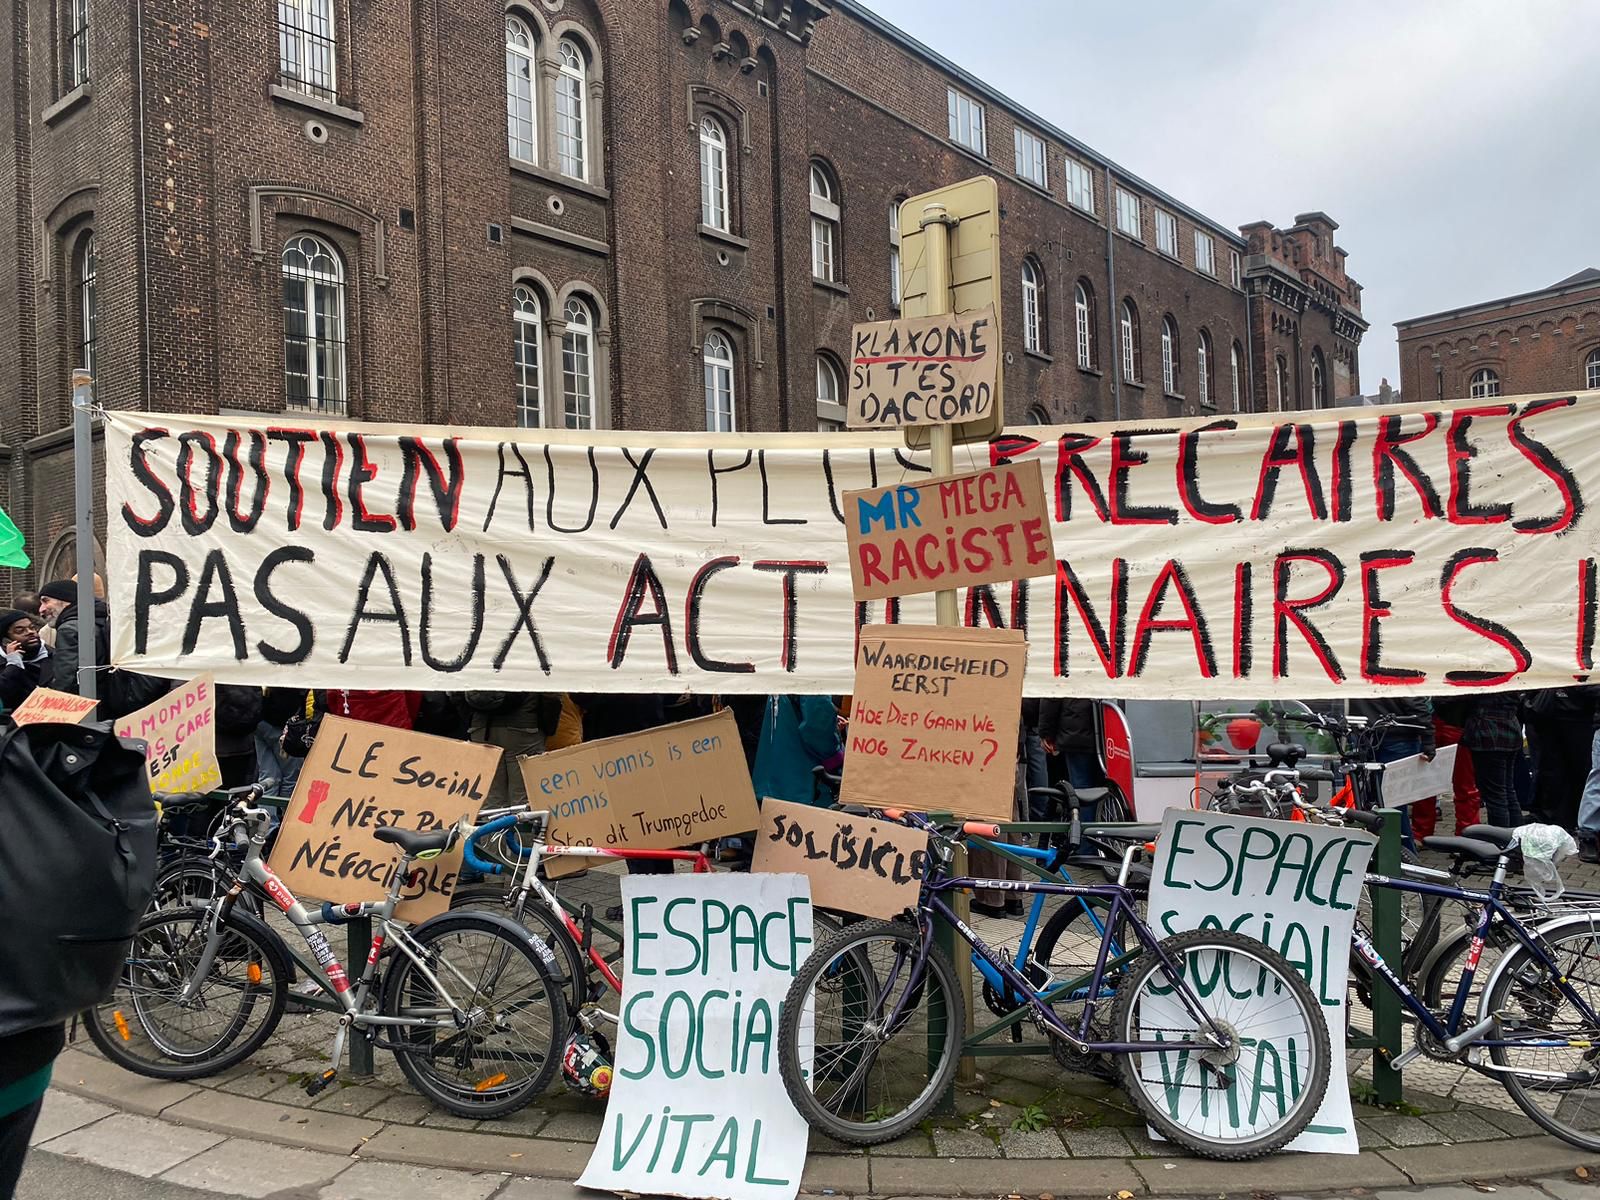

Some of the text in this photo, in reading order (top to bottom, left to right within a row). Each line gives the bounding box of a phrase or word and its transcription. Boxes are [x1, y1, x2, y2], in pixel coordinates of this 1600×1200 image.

[854, 318, 988, 357] KLAXONE
[121, 426, 465, 537] SOUTIEN
[482, 441, 668, 534] AUX
[857, 471, 1027, 534] MR MEGA
[134, 544, 316, 665] PAS
[338, 550, 557, 676] AUX
[891, 672, 957, 697] EERST
[141, 682, 207, 737] MONDE
[176, 707, 212, 743] CARE
[150, 744, 181, 778] EST
[330, 732, 385, 779] LE
[540, 734, 723, 795] een vonnis is een
[852, 737, 889, 756] NOG
[549, 789, 609, 821] vonnis
[606, 823, 629, 845] dit
[632, 793, 728, 838] Trumpgedoe
[974, 879, 1031, 892] SCOTT
[1163, 820, 1374, 910] ESPACE
[631, 896, 812, 977] ESPACE
